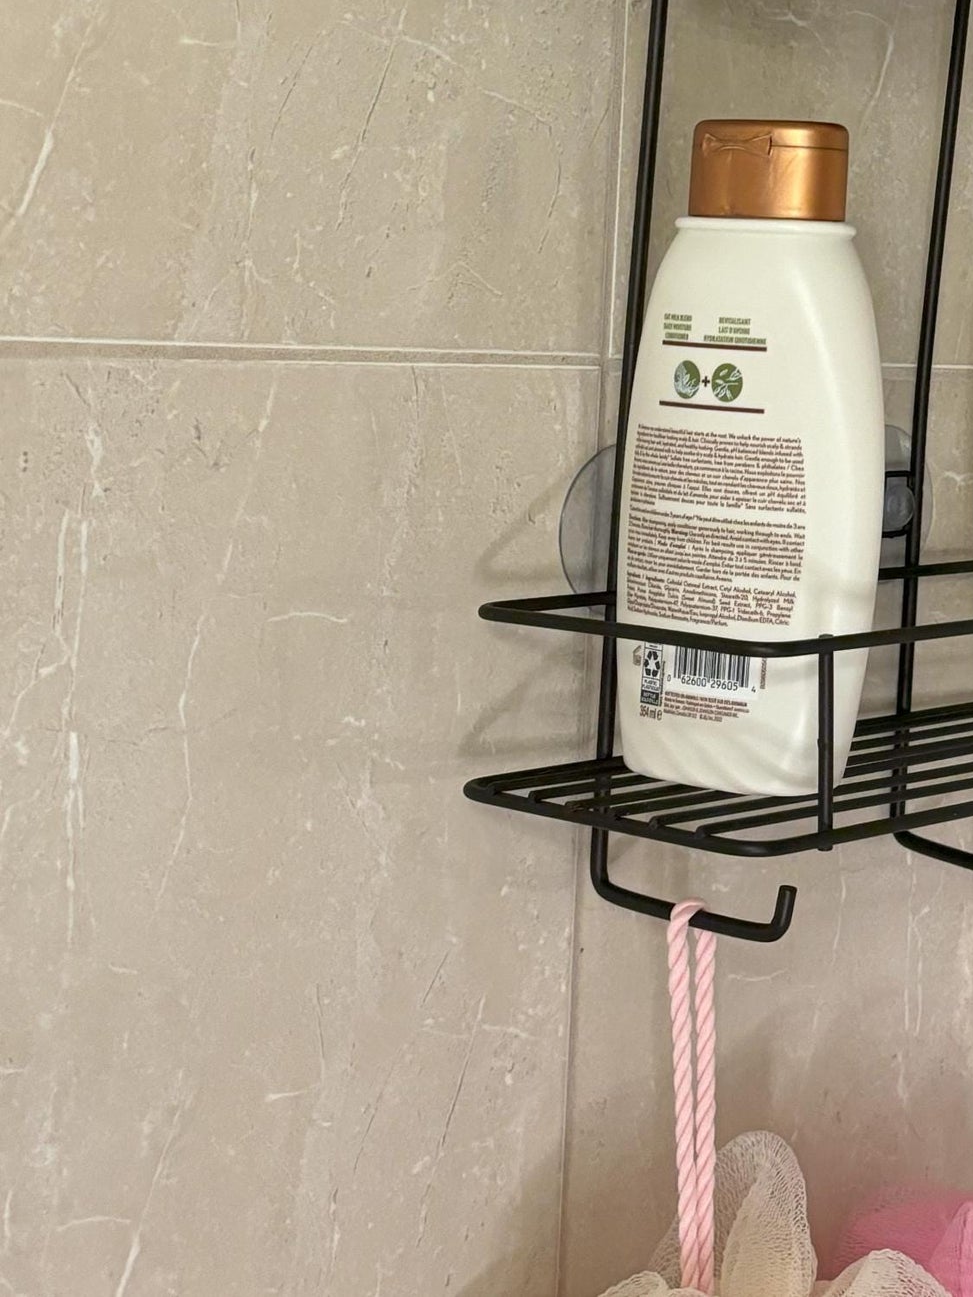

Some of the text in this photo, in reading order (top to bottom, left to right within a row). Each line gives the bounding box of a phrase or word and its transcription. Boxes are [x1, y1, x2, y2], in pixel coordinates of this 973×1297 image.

[667, 674, 672, 682] 0
[681, 675, 707, 688] 62600
[710, 680, 738, 691] 29605
